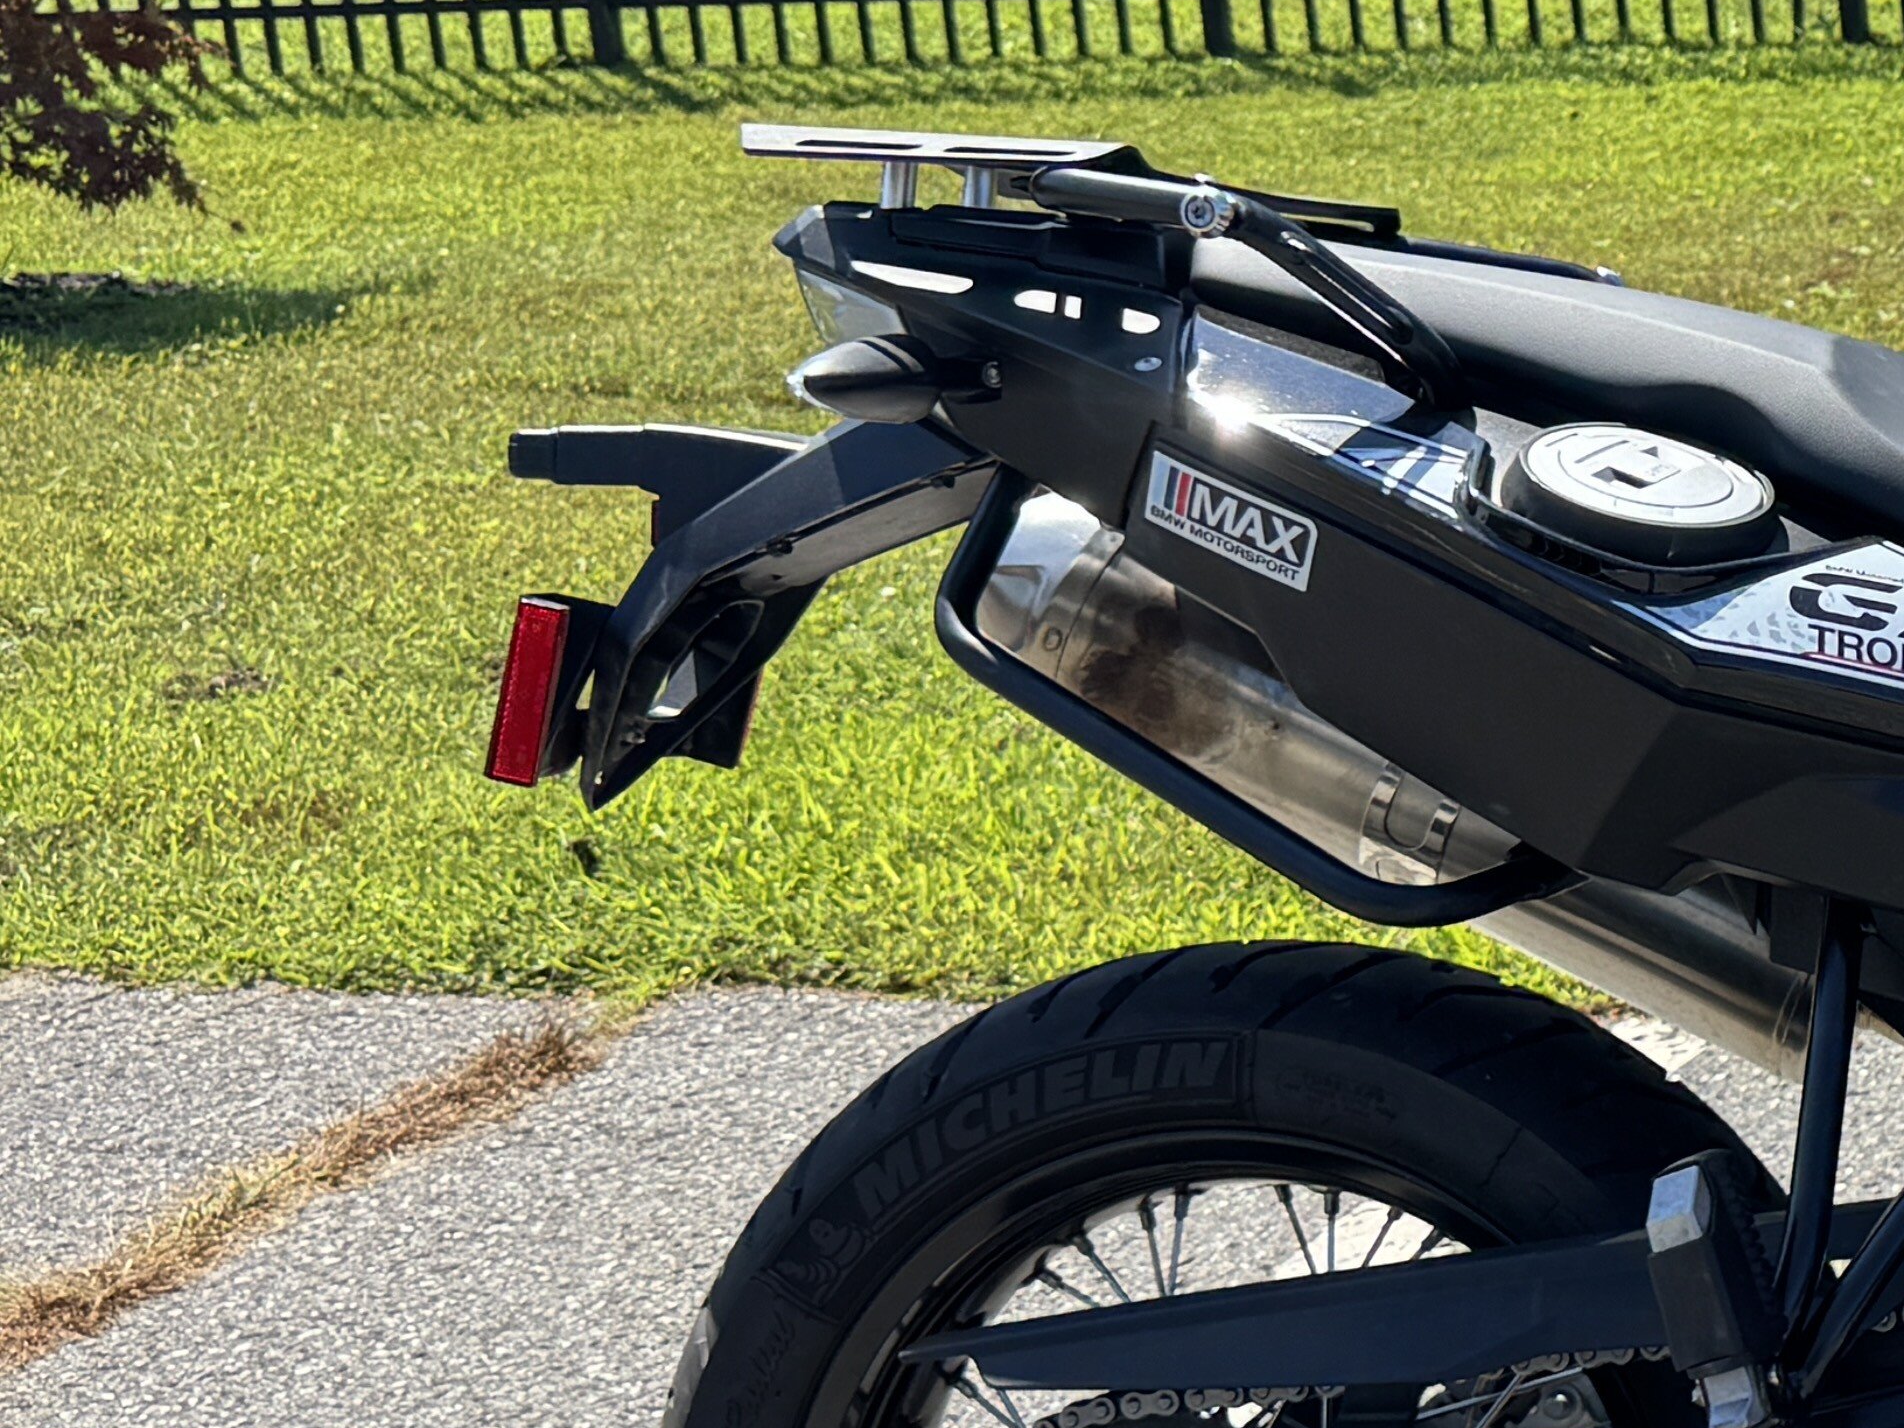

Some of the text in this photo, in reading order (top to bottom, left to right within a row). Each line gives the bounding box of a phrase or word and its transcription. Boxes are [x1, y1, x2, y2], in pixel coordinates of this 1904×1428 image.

[1150, 504, 1300, 581] BMW MOTORSPORT
[852, 1040, 1233, 1220] MICHELIN
